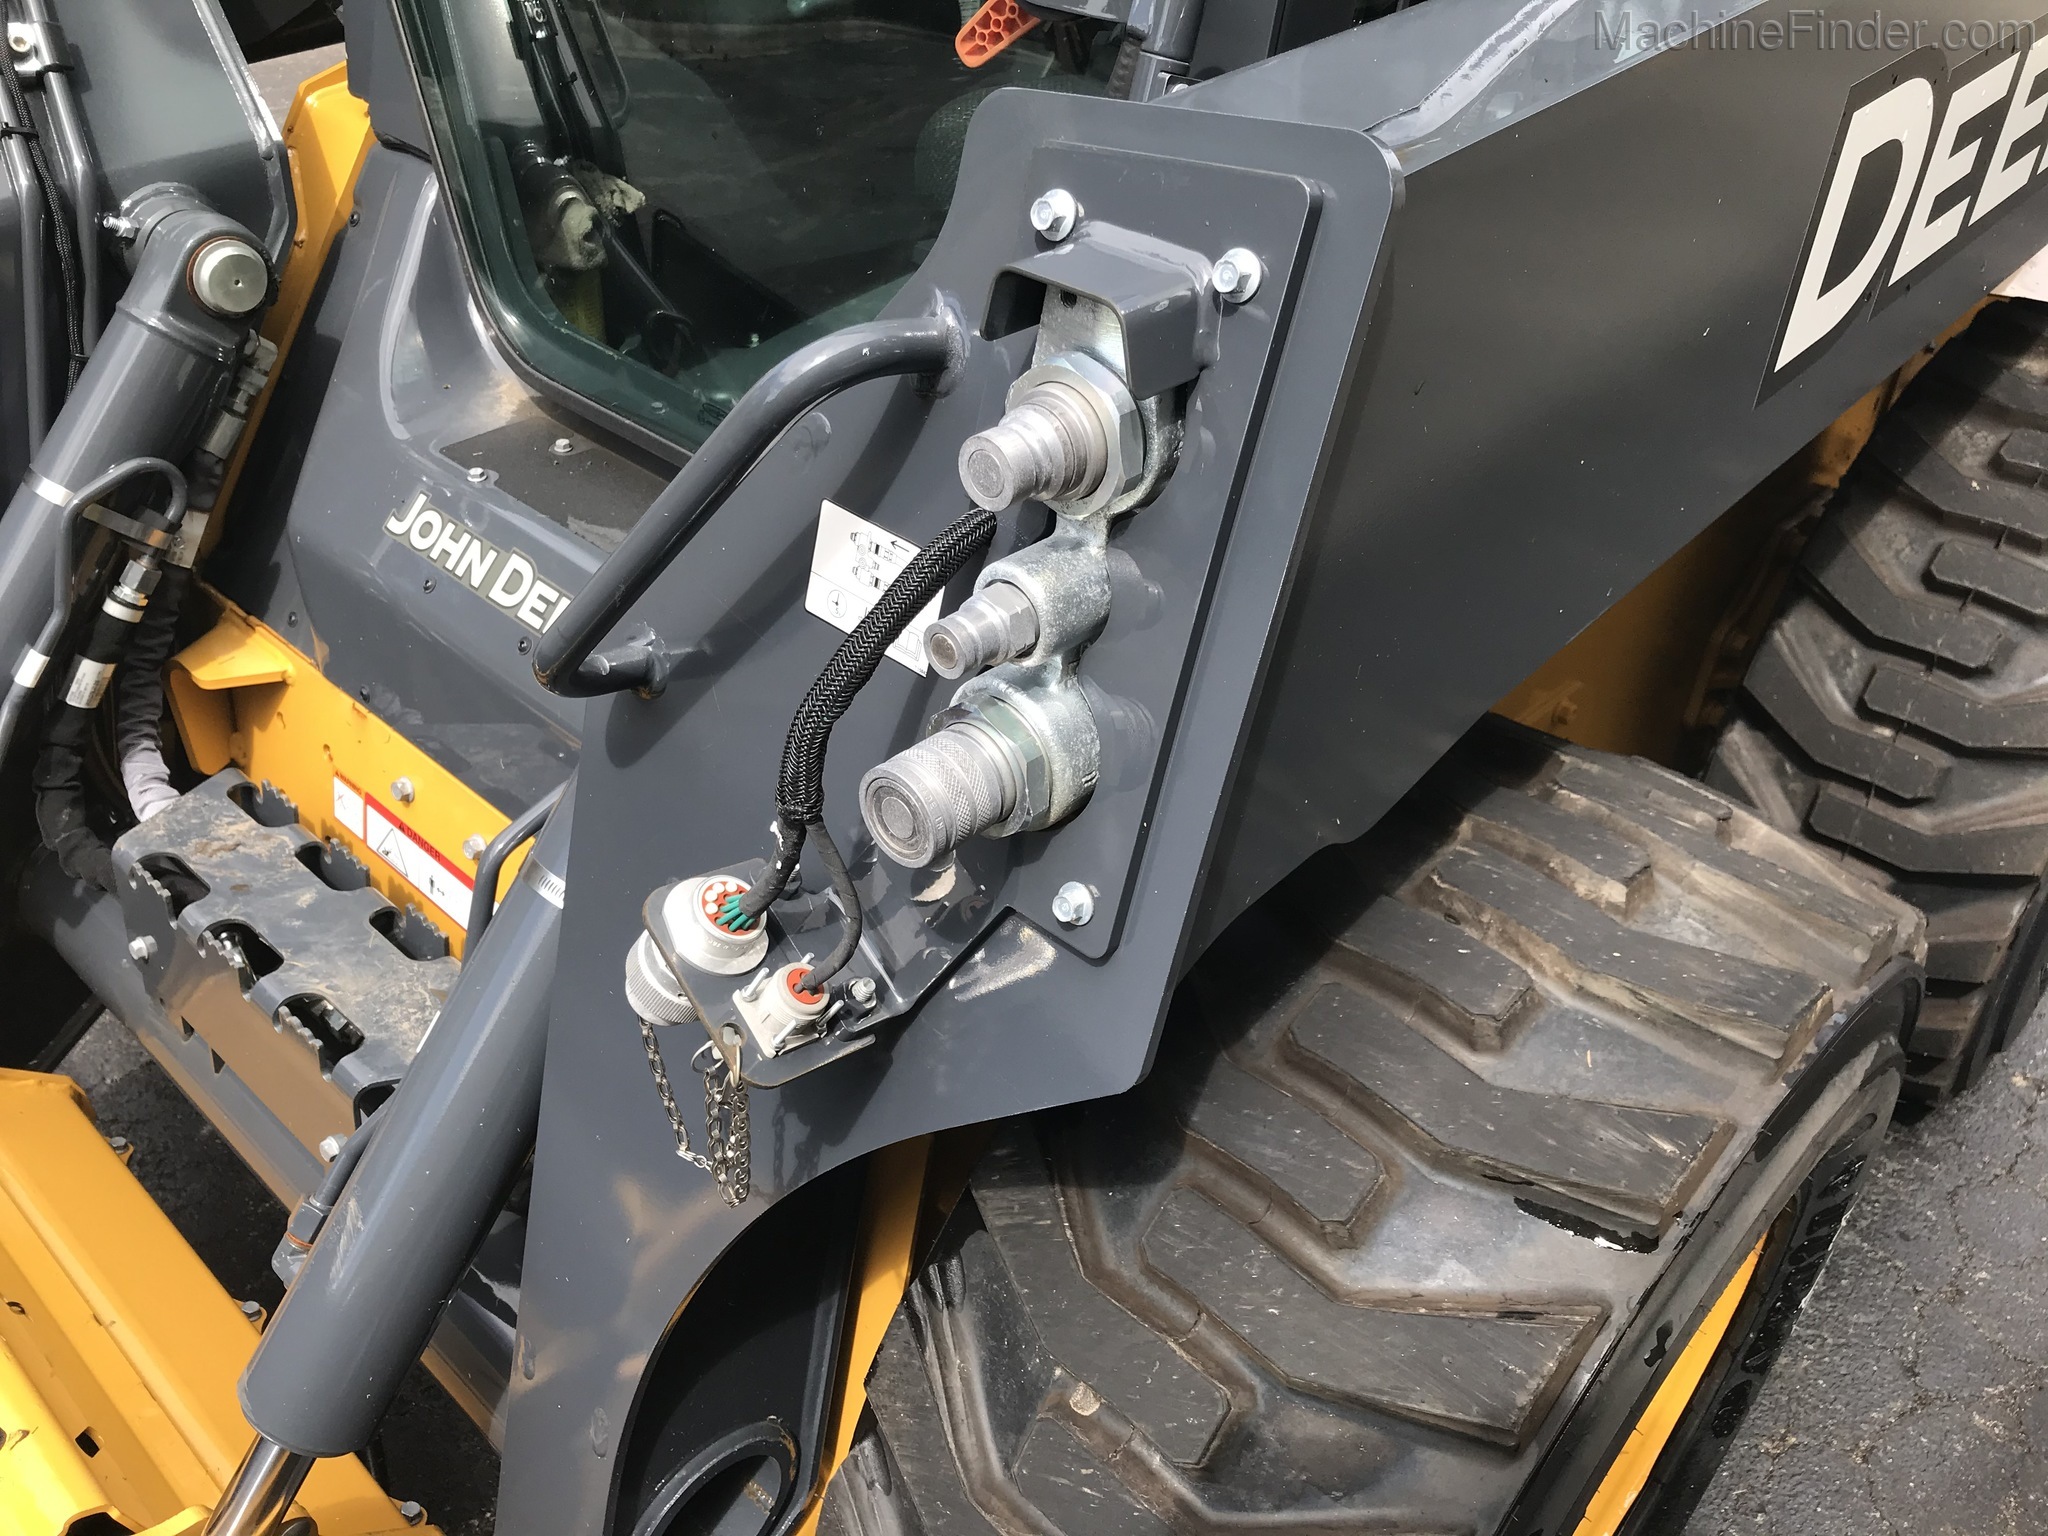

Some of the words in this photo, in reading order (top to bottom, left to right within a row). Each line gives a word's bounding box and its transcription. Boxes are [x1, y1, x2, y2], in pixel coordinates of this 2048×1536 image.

[1773, 36, 2048, 374] DEE
[386, 492, 498, 588] JOHN
[406, 827, 441, 862] DANGER
